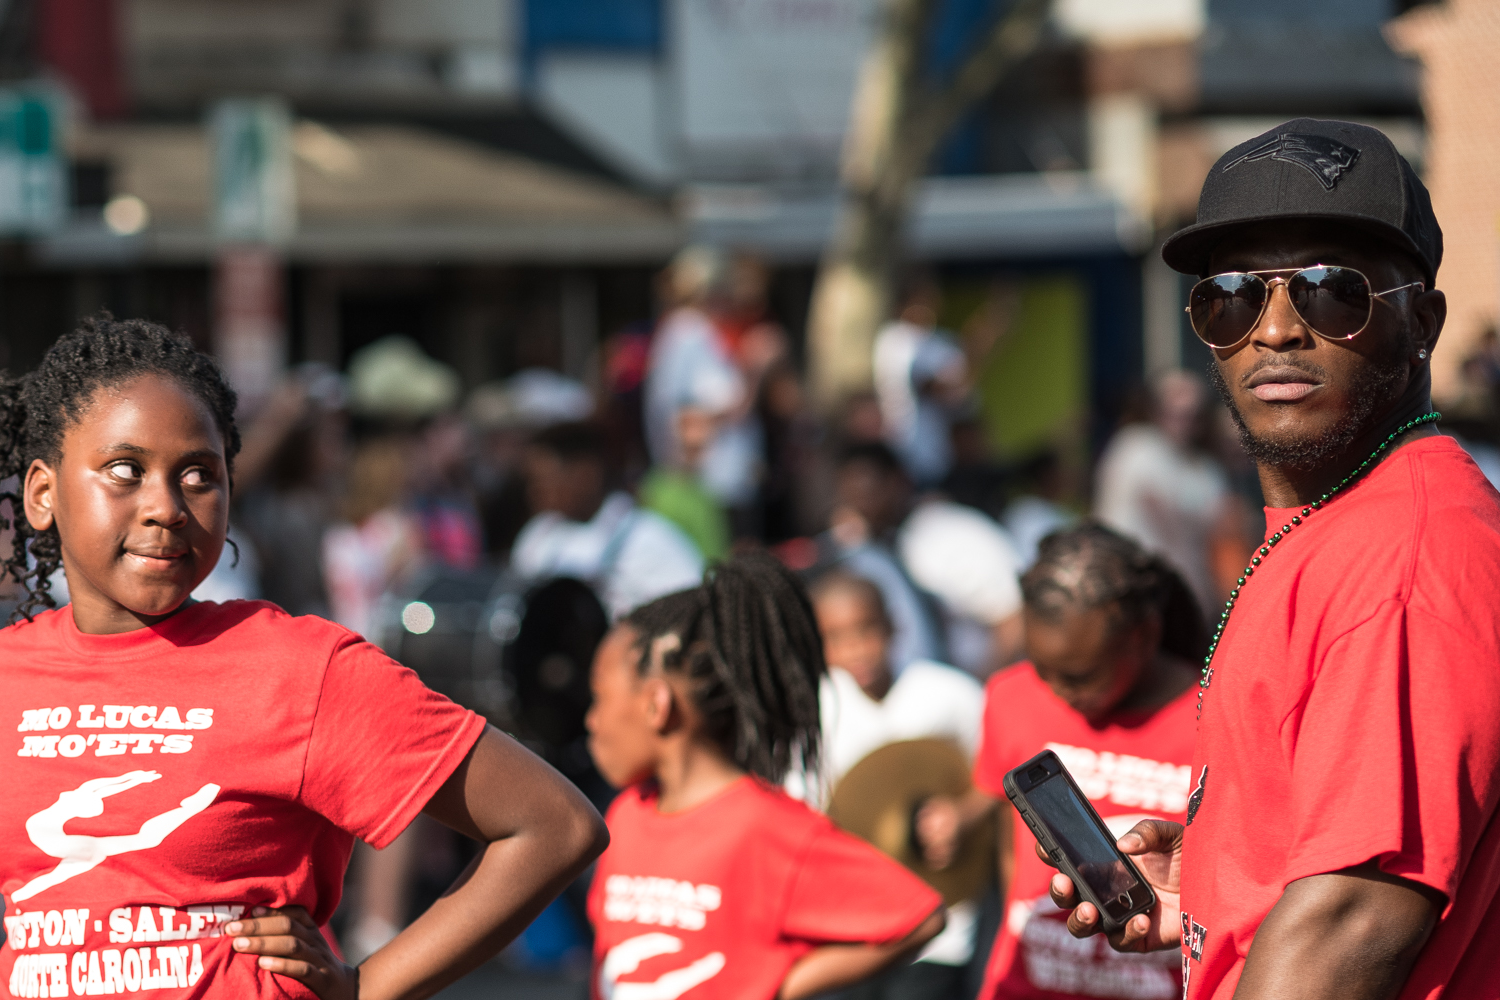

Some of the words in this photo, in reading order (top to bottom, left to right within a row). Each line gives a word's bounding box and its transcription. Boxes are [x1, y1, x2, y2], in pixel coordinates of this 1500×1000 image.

[17, 706, 72, 732] MO
[76, 704, 214, 730] LUCAS
[17, 733, 194, 758] MO'ETS
[71, 943, 204, 996] CAROLINA
